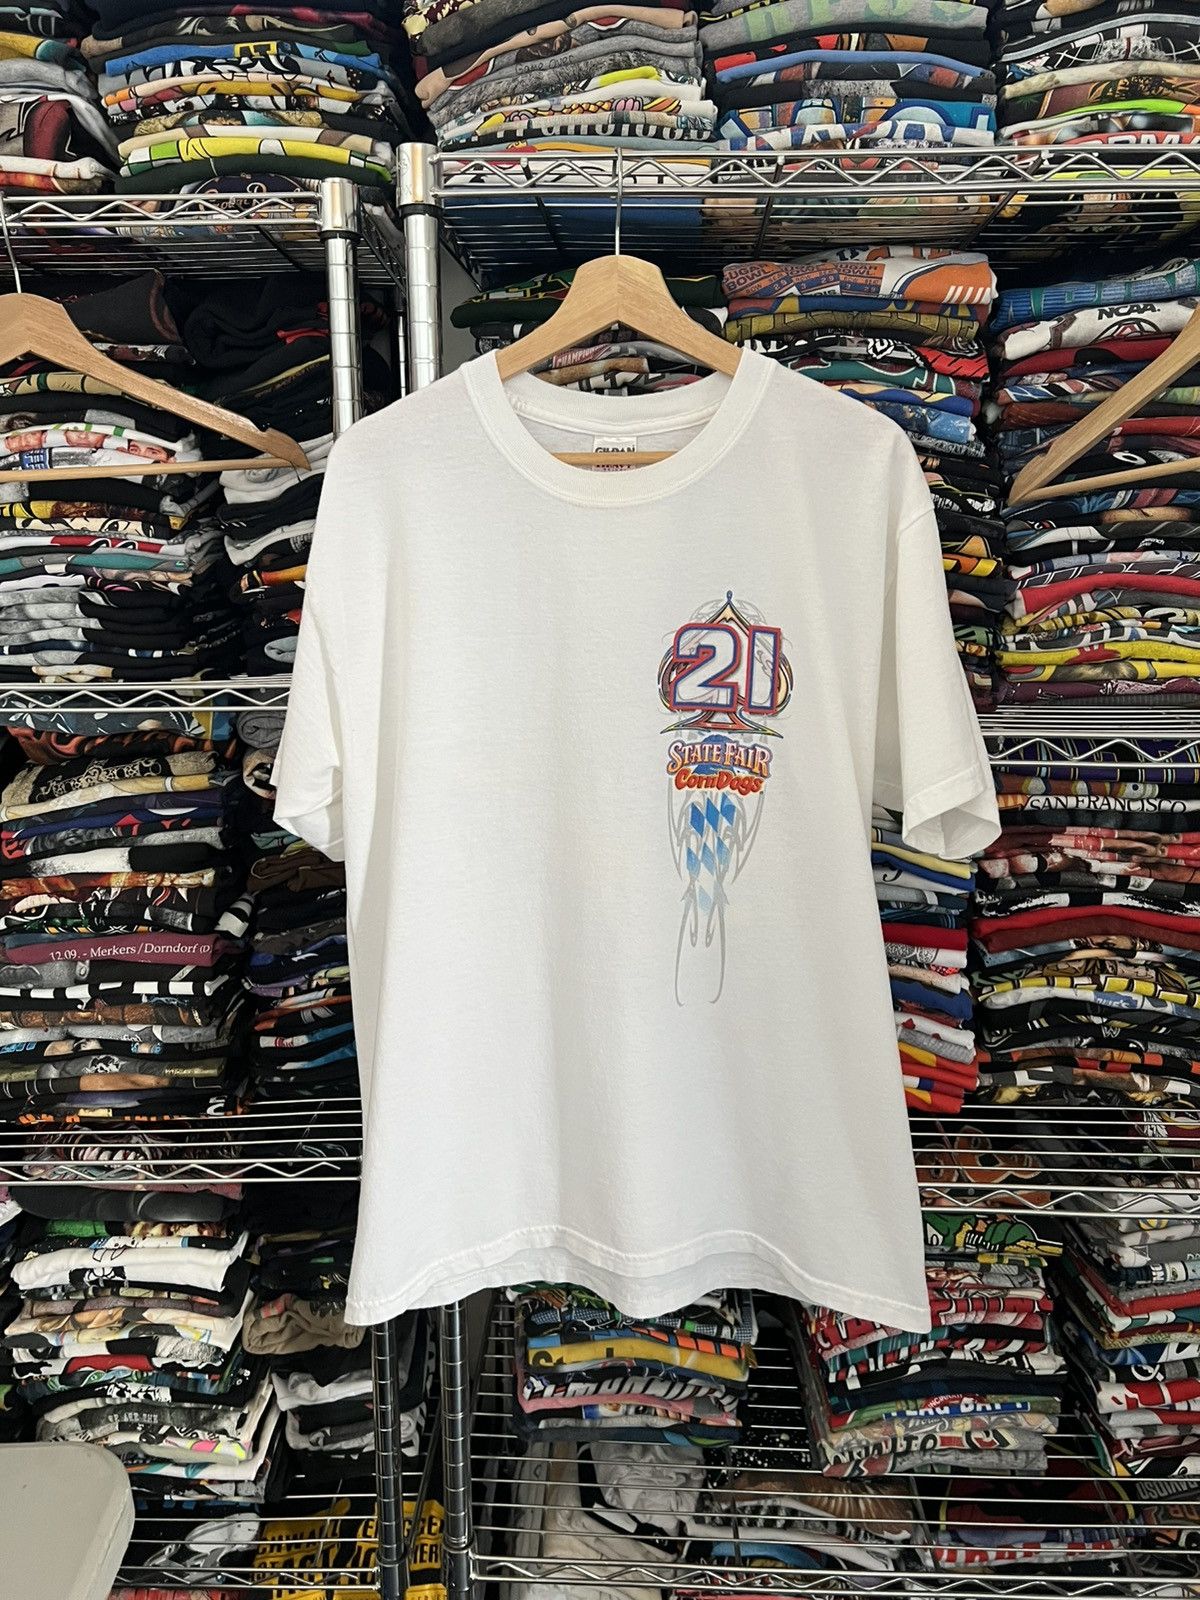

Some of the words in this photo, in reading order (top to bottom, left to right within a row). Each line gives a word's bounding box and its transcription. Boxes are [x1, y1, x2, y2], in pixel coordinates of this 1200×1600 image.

[669, 622, 782, 714] 21
[667, 740, 722, 775] STATE
[723, 741, 773, 778] FAIR
[1029, 795, 1069, 811] SAN
[1075, 795, 1187, 814] FRANCISCO
